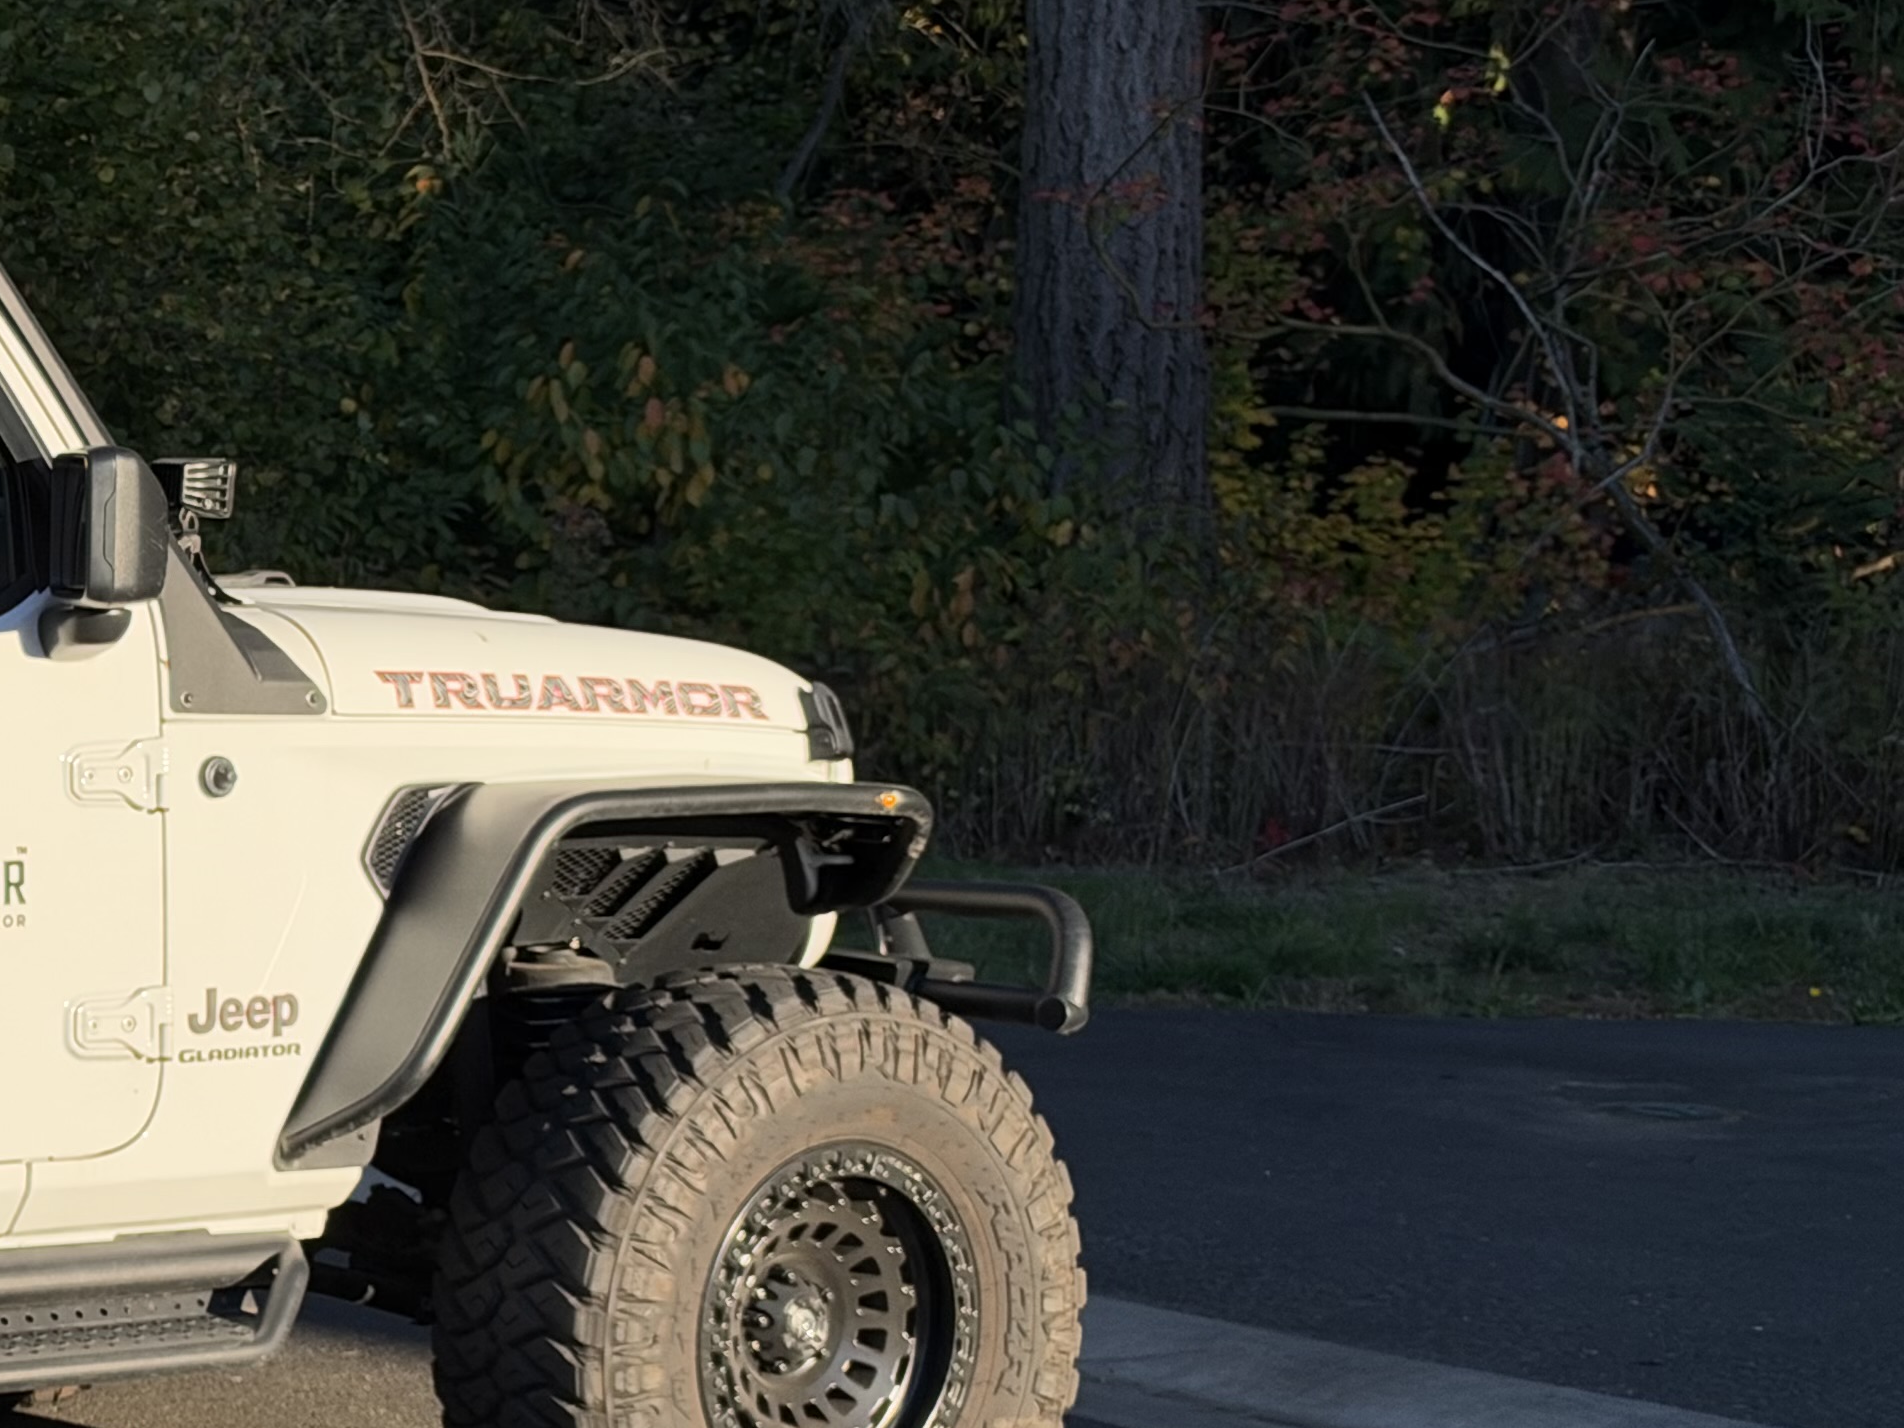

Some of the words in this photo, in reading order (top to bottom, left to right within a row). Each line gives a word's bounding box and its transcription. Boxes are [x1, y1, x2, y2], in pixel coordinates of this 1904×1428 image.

[373, 670, 770, 721] TRUARMOR
[187, 987, 299, 1037] Jeep
[178, 1042, 302, 1063] GLADIATOR
